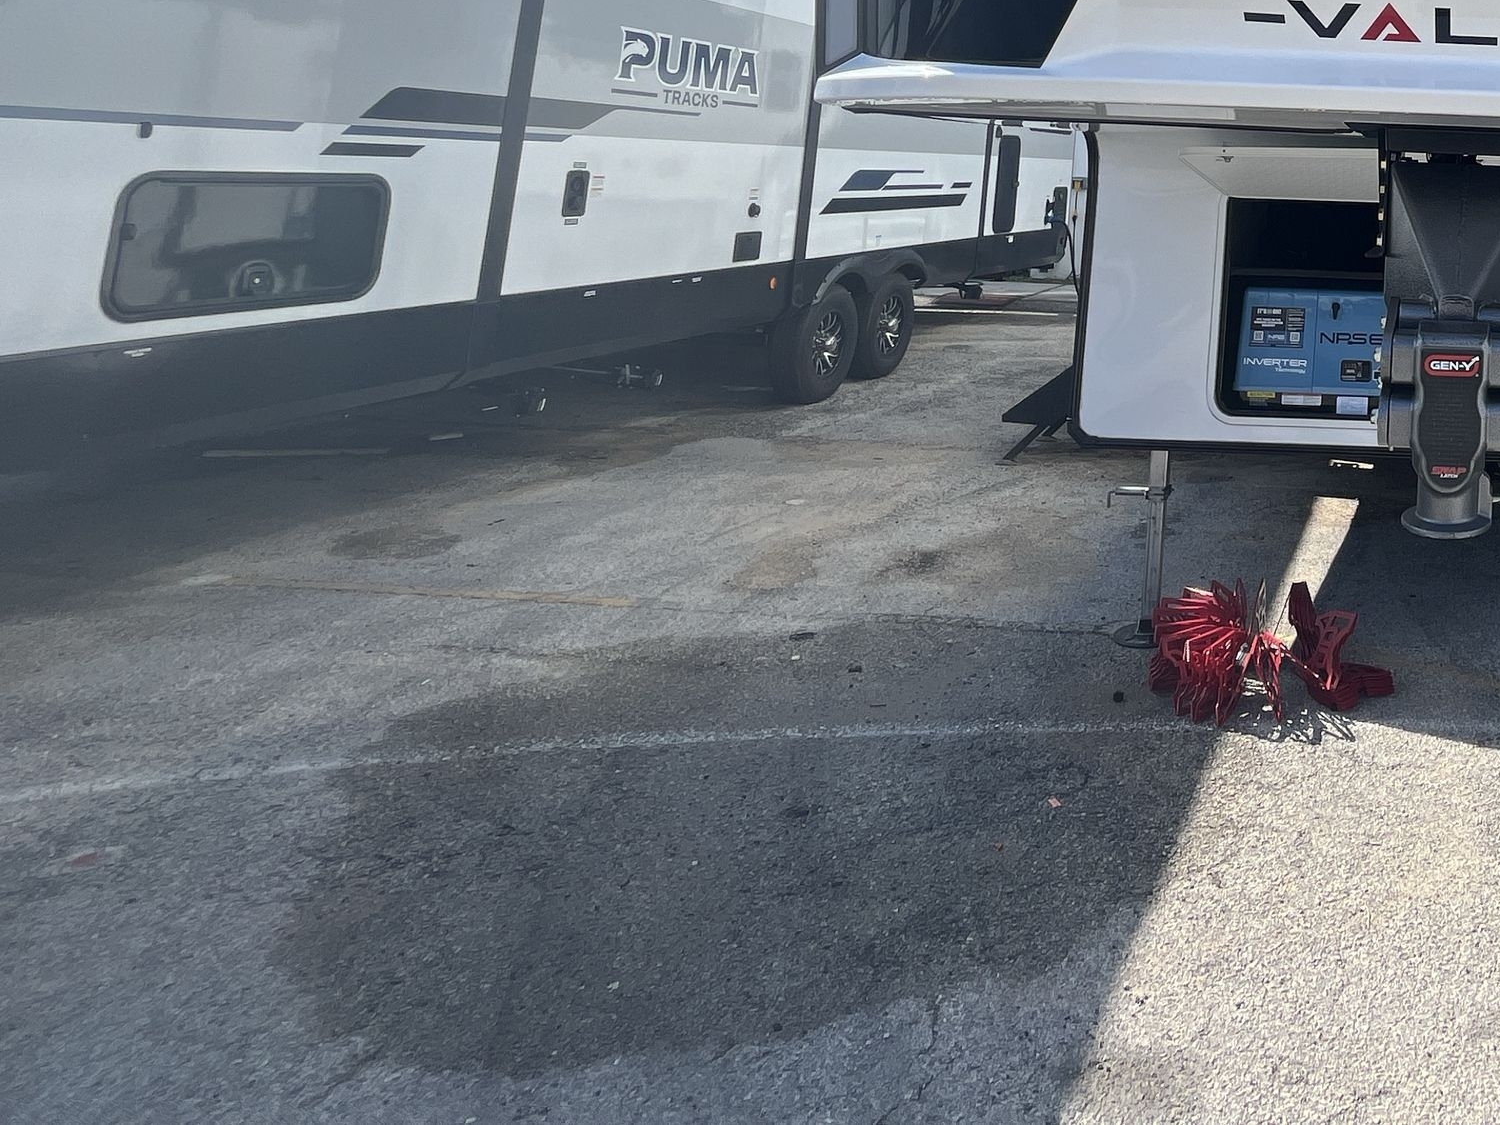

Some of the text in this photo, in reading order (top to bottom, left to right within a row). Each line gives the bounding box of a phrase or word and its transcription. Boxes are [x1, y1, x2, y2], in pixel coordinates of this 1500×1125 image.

[615, 26, 760, 98] PUMA
[663, 89, 719, 109] TRACKS
[1243, 357, 1308, 368] INVERTER
[1430, 356, 1480, 372] GEN-Y
